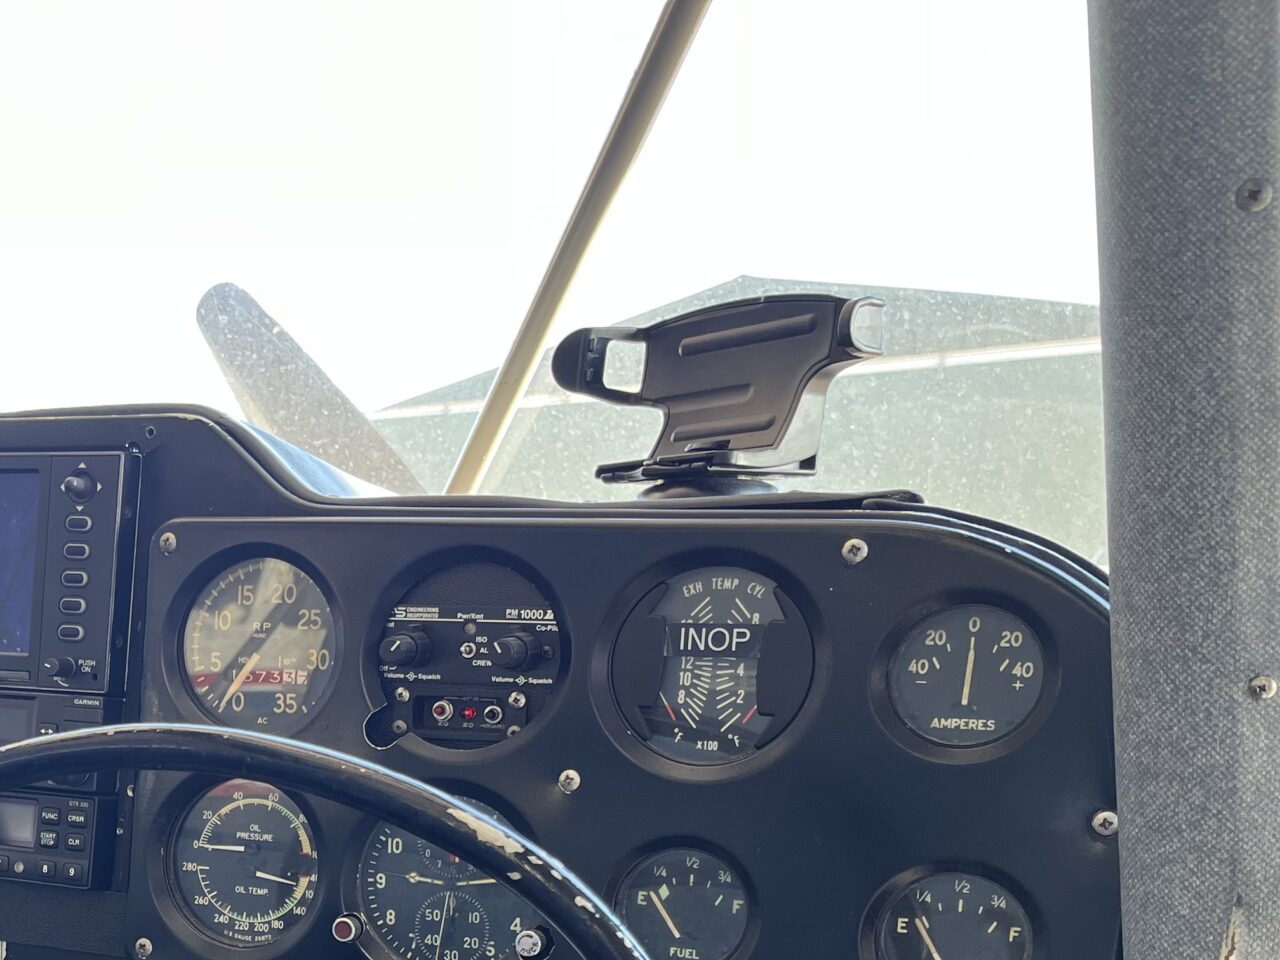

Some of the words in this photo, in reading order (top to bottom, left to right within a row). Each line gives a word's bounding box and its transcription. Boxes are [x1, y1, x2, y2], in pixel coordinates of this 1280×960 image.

[238, 585, 254, 606] 15
[272, 584, 297, 604] 20
[683, 582, 703, 597] EXH
[712, 578, 739, 590] TEMP
[747, 582, 766, 599] CYL
[214, 611, 231, 631] 10
[297, 610, 321, 630] 25
[520, 610, 543, 619] 1000
[969, 617, 980, 632] 0
[680, 627, 751, 651] INOP
[925, 630, 946, 645] 20
[1000, 631, 1023, 647] 20
[211, 652, 221, 672] 5
[307, 649, 329, 670] 30
[908, 659, 929, 674] 40
[1011, 662, 1034, 678] 40
[679, 672, 691, 686] 10
[232, 692, 245, 712] 0
[273, 694, 297, 713] 35
[930, 718, 996, 731] AMPERES
[236, 832, 273, 842] PRESSURE
[387, 837, 402, 854] 10
[376, 873, 386, 889] 9
[235, 886, 246, 894] OIL
[248, 887, 269, 896] TEMP.
[638, 891, 648, 905] E
[732, 900, 744, 914] F
[991, 895, 1007, 909] 3/4
[386, 910, 396, 925] 8
[425, 910, 440, 921] 50
[469, 912, 480, 924] 10
[897, 918, 909, 933] E
[1009, 927, 1021, 942] F
[464, 937, 479, 948] 20
[670, 947, 700, 960] FUEL
